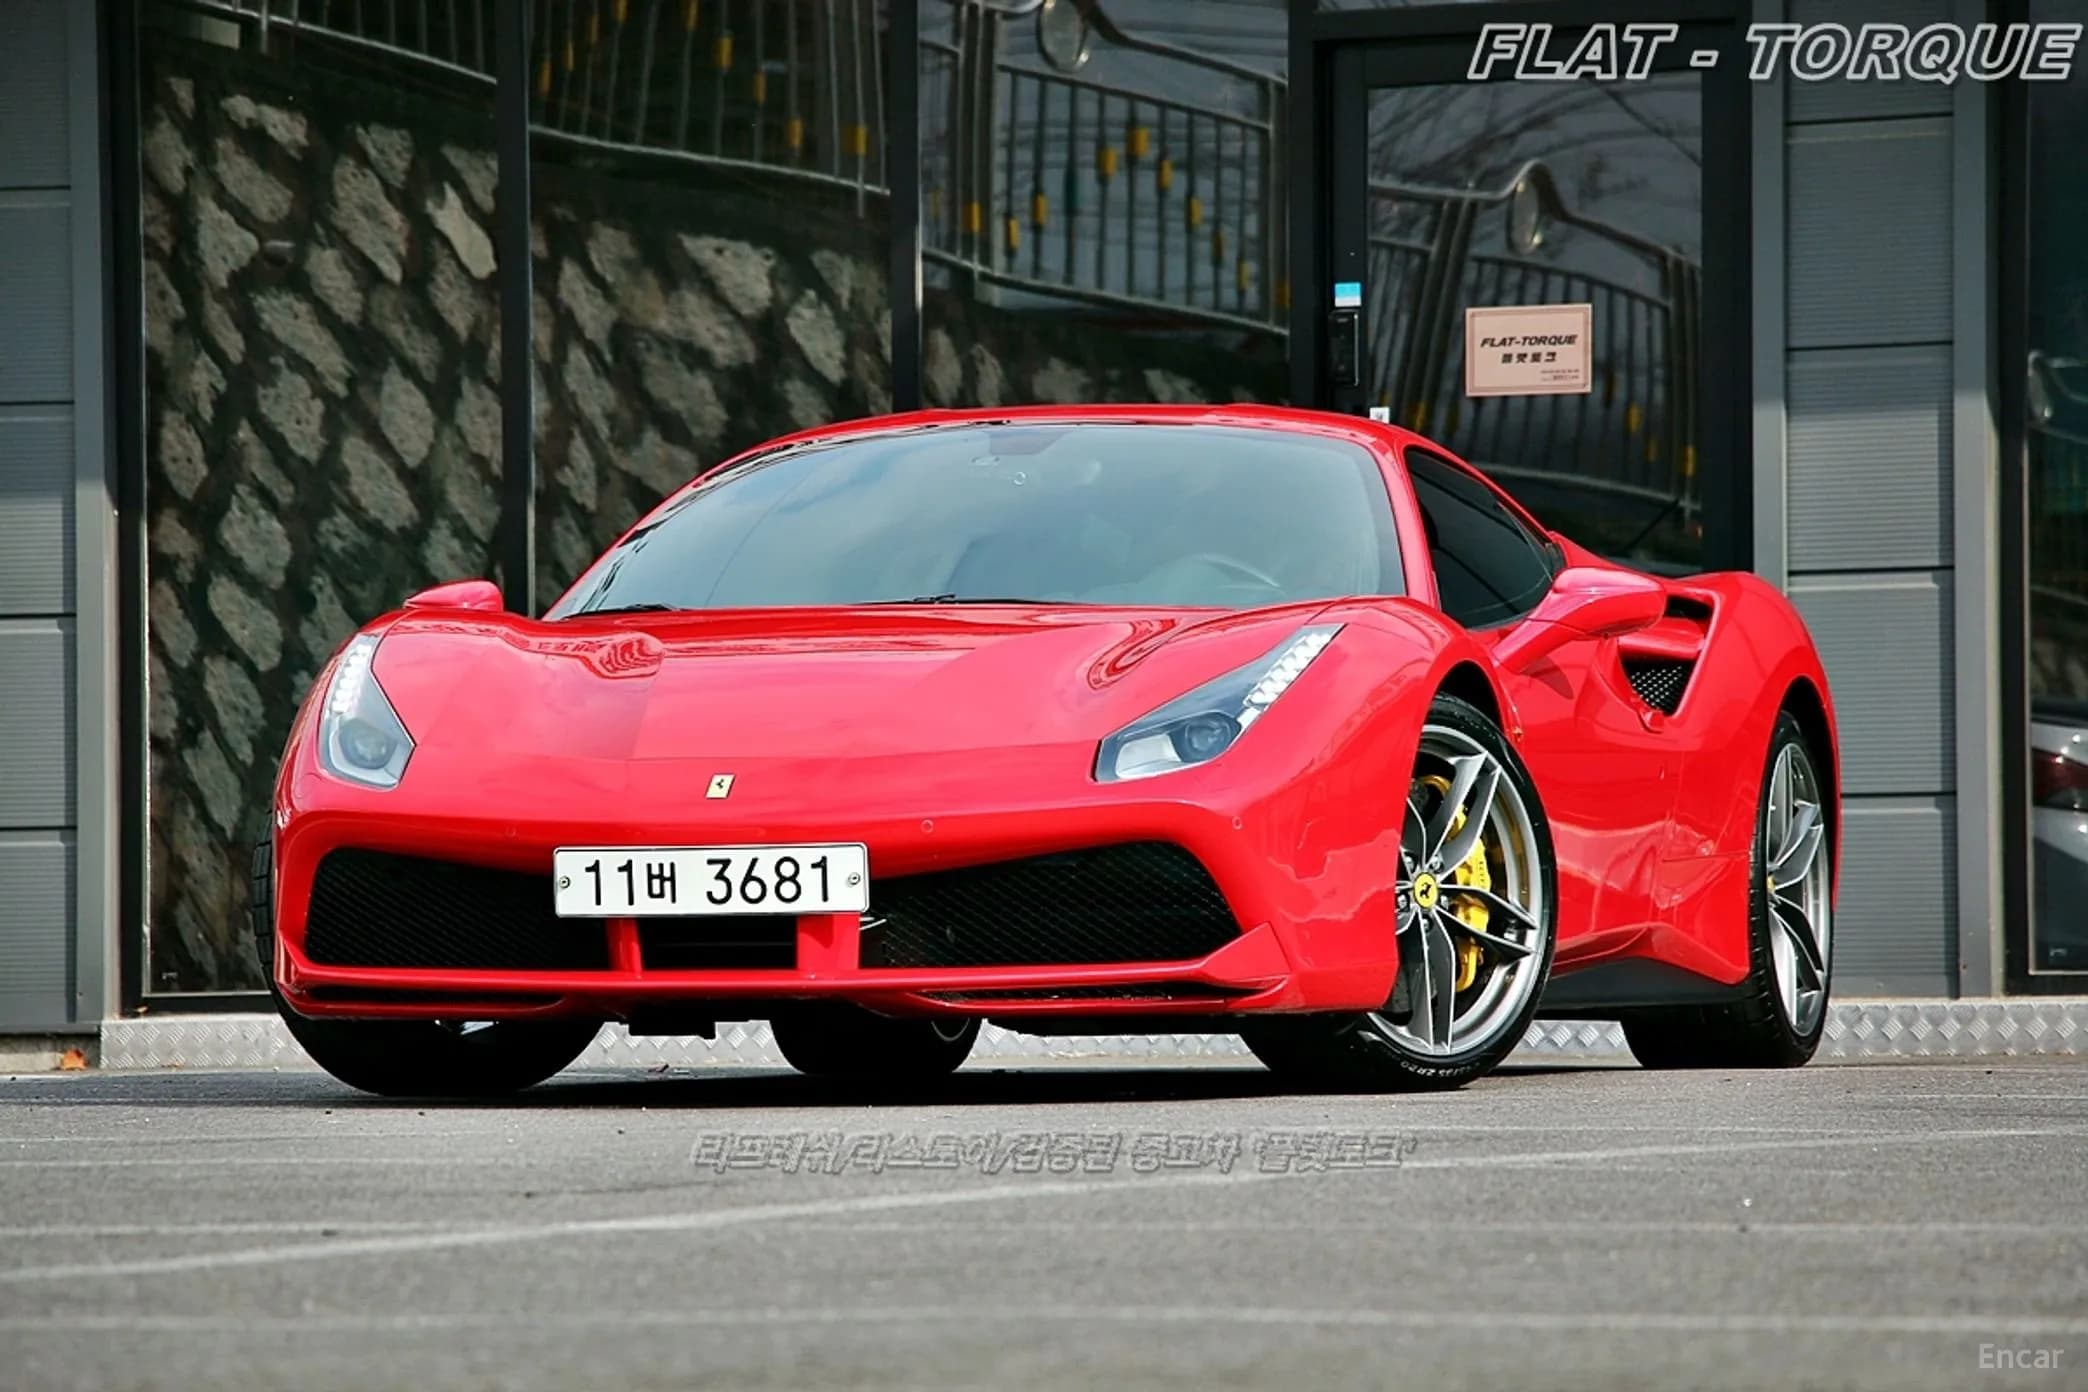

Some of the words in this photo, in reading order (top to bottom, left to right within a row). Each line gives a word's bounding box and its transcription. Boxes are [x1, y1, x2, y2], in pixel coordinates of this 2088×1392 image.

[1480, 334, 1578, 348] FLAT-TORQUE
[585, 859, 676, 906] 11버
[706, 855, 829, 905] 3681
